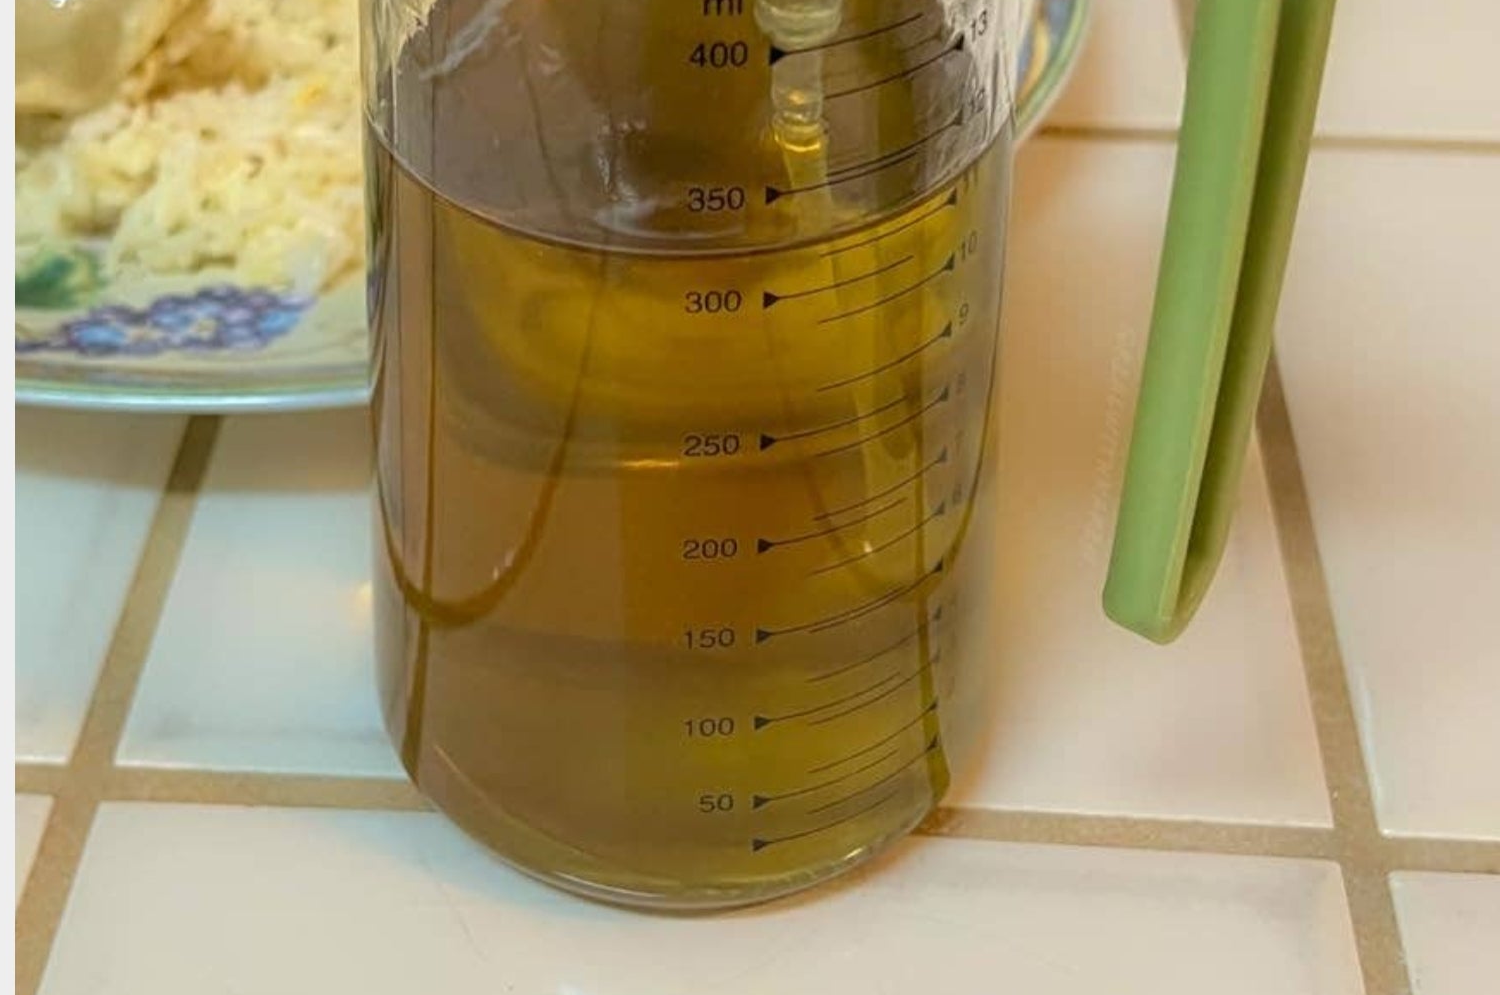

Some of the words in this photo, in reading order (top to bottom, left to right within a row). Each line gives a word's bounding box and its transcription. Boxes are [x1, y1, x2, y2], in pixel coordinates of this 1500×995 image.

[689, 40, 749, 68] 400
[688, 186, 745, 212] 350
[685, 289, 742, 313] 300
[684, 434, 739, 456] 250
[683, 538, 737, 559] 200
[685, 628, 735, 649] 150
[685, 717, 735, 737] 100
[699, 794, 734, 813] 50
